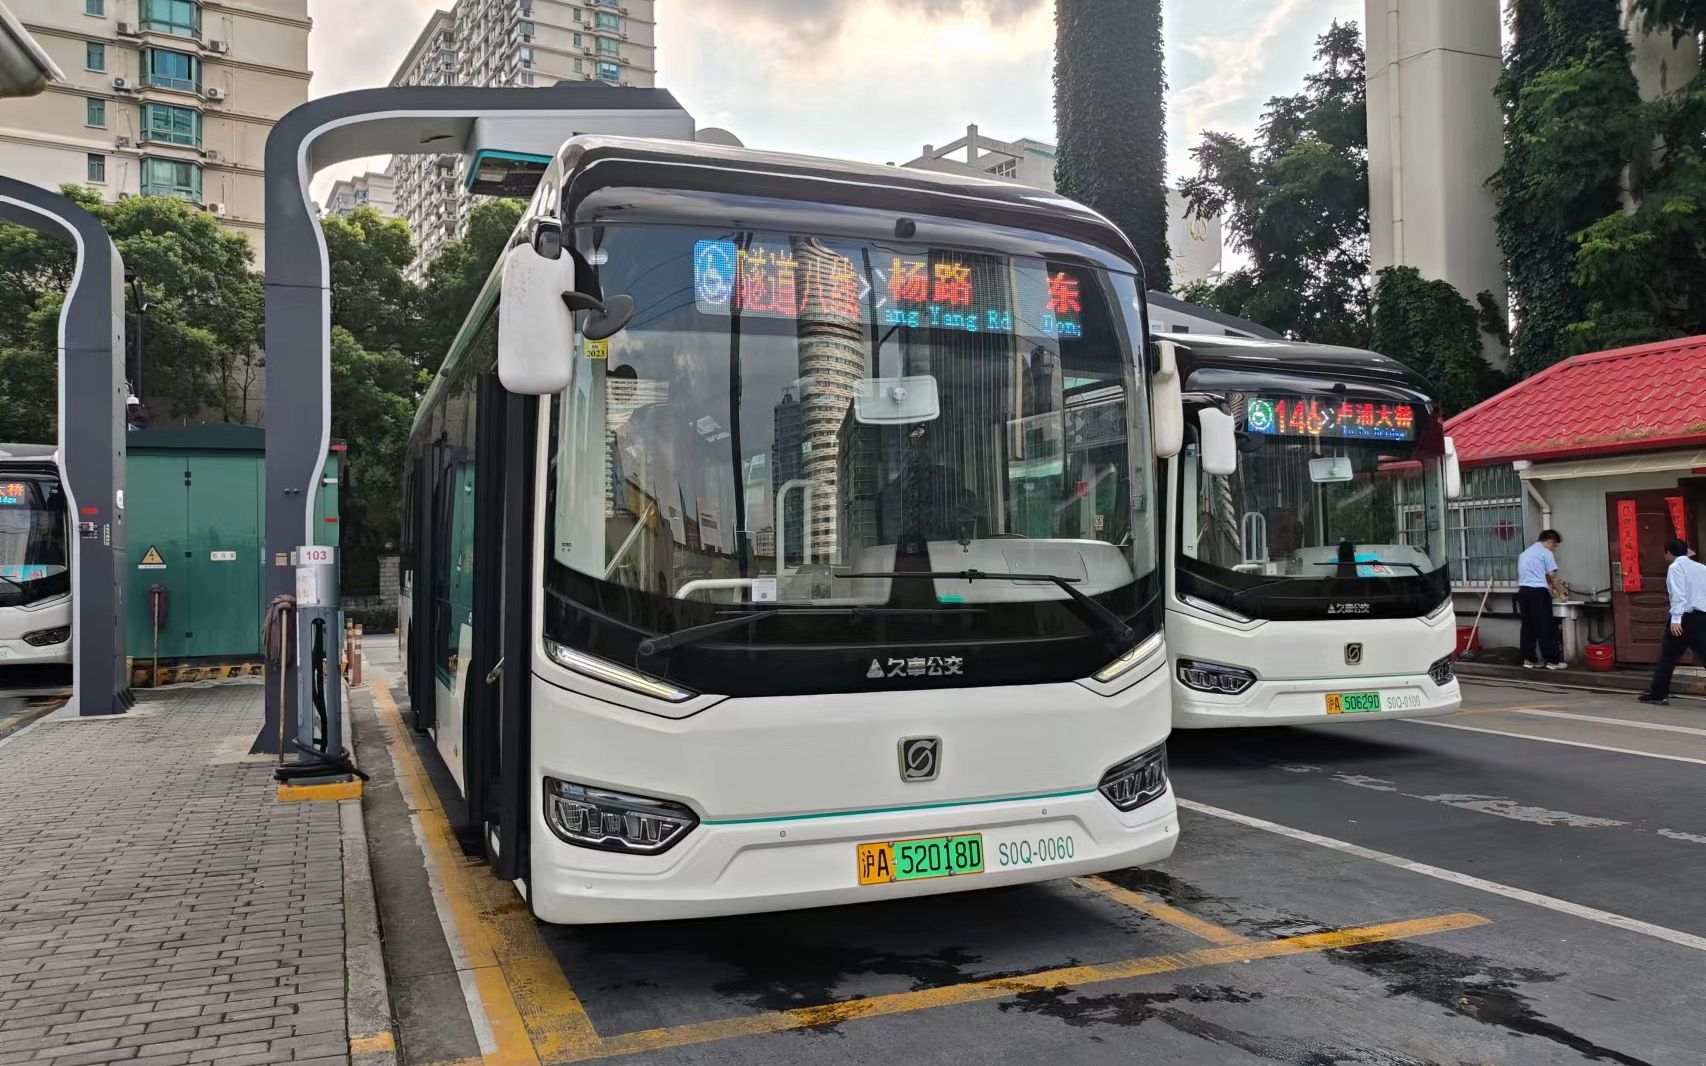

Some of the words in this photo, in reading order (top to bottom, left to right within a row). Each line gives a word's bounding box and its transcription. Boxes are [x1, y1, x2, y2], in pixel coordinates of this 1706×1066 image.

[1046, 271, 1082, 313] 东
[586, 350, 605, 358] 2023
[306, 550, 327, 561] 103
